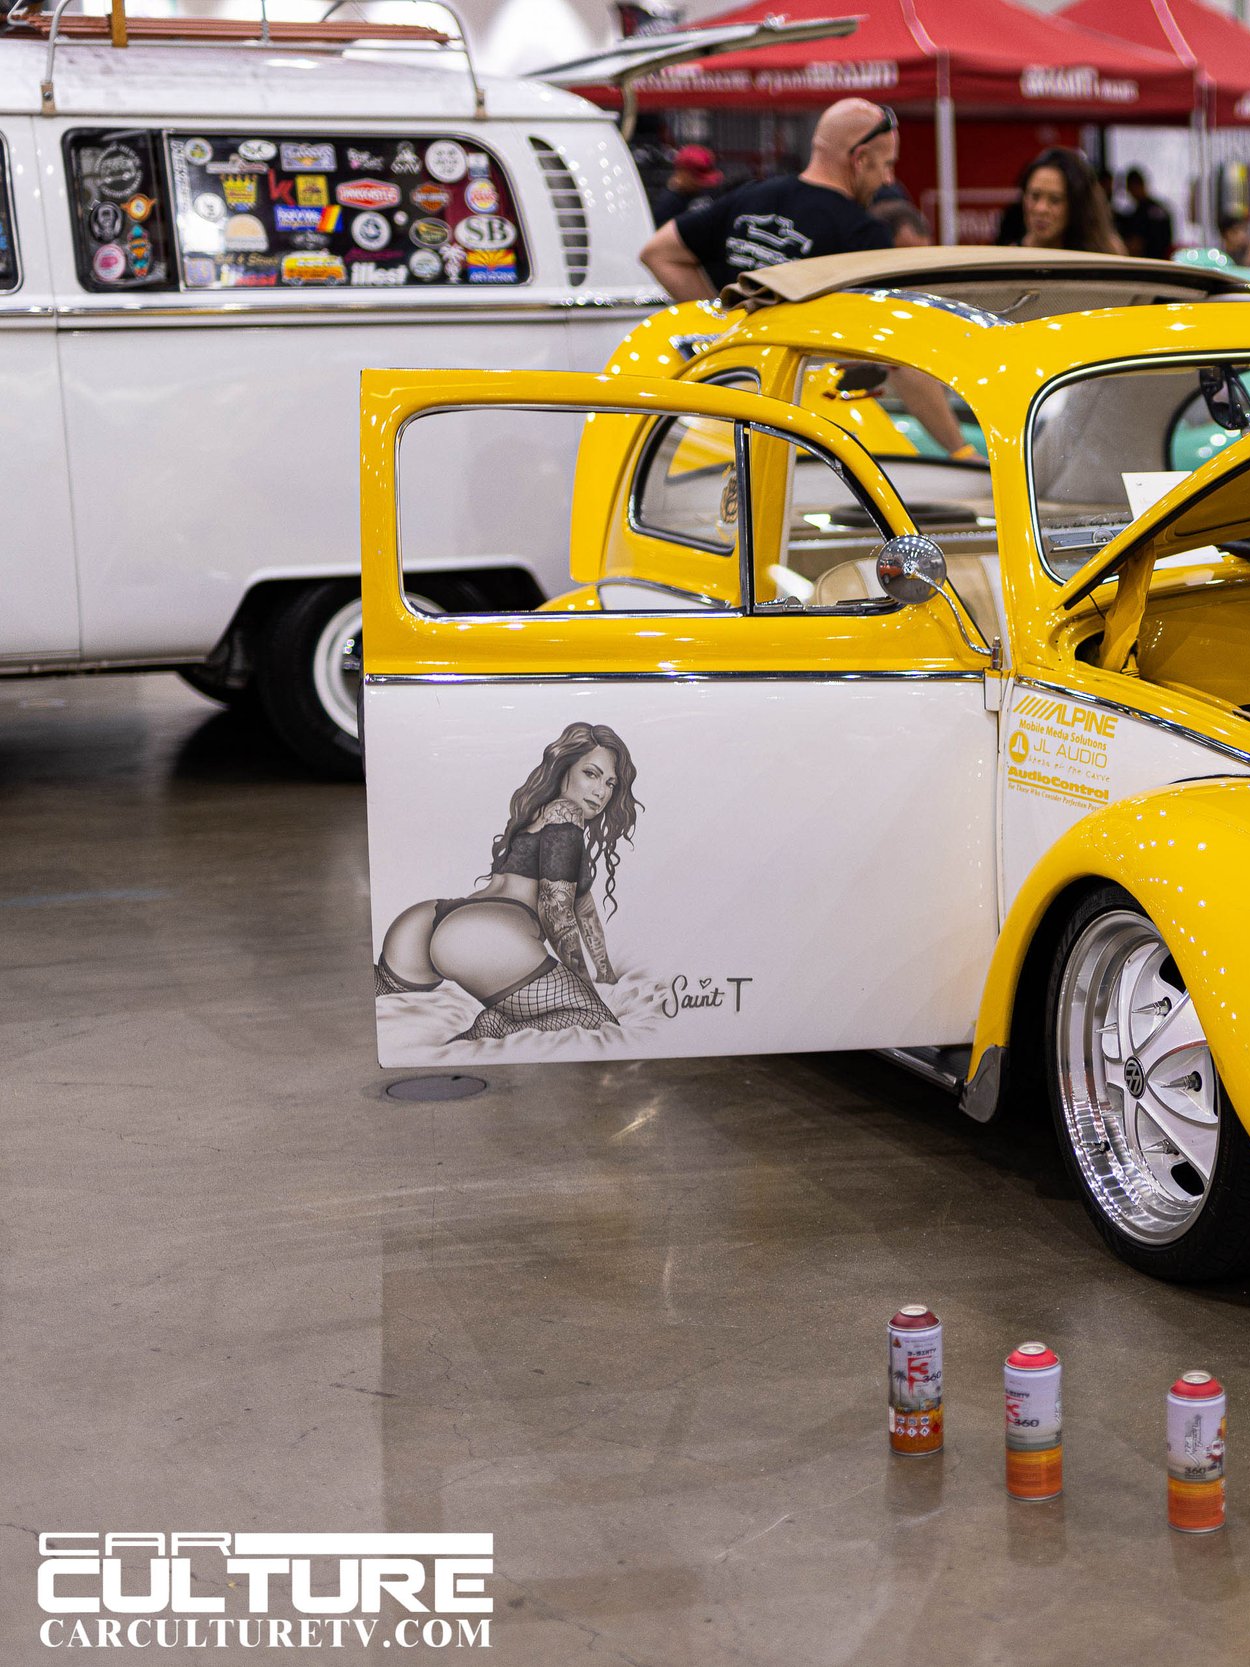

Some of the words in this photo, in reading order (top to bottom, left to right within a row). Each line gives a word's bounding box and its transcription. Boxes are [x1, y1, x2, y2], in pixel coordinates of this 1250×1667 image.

[465, 217, 508, 242] SB
[351, 262, 408, 285] illest
[1019, 719, 1045, 735] Mobile
[1046, 726, 1069, 740] Media
[1070, 733, 1107, 751] Solutions
[1033, 738, 1051, 754] JL
[1055, 743, 1108, 769] AUDIO
[1007, 766, 1110, 800] AudioControl
[661, 974, 725, 1019] Saint
[726, 977, 753, 1013] T
[922, 1370, 942, 1384] 360
[1013, 1418, 1040, 1428] 360
